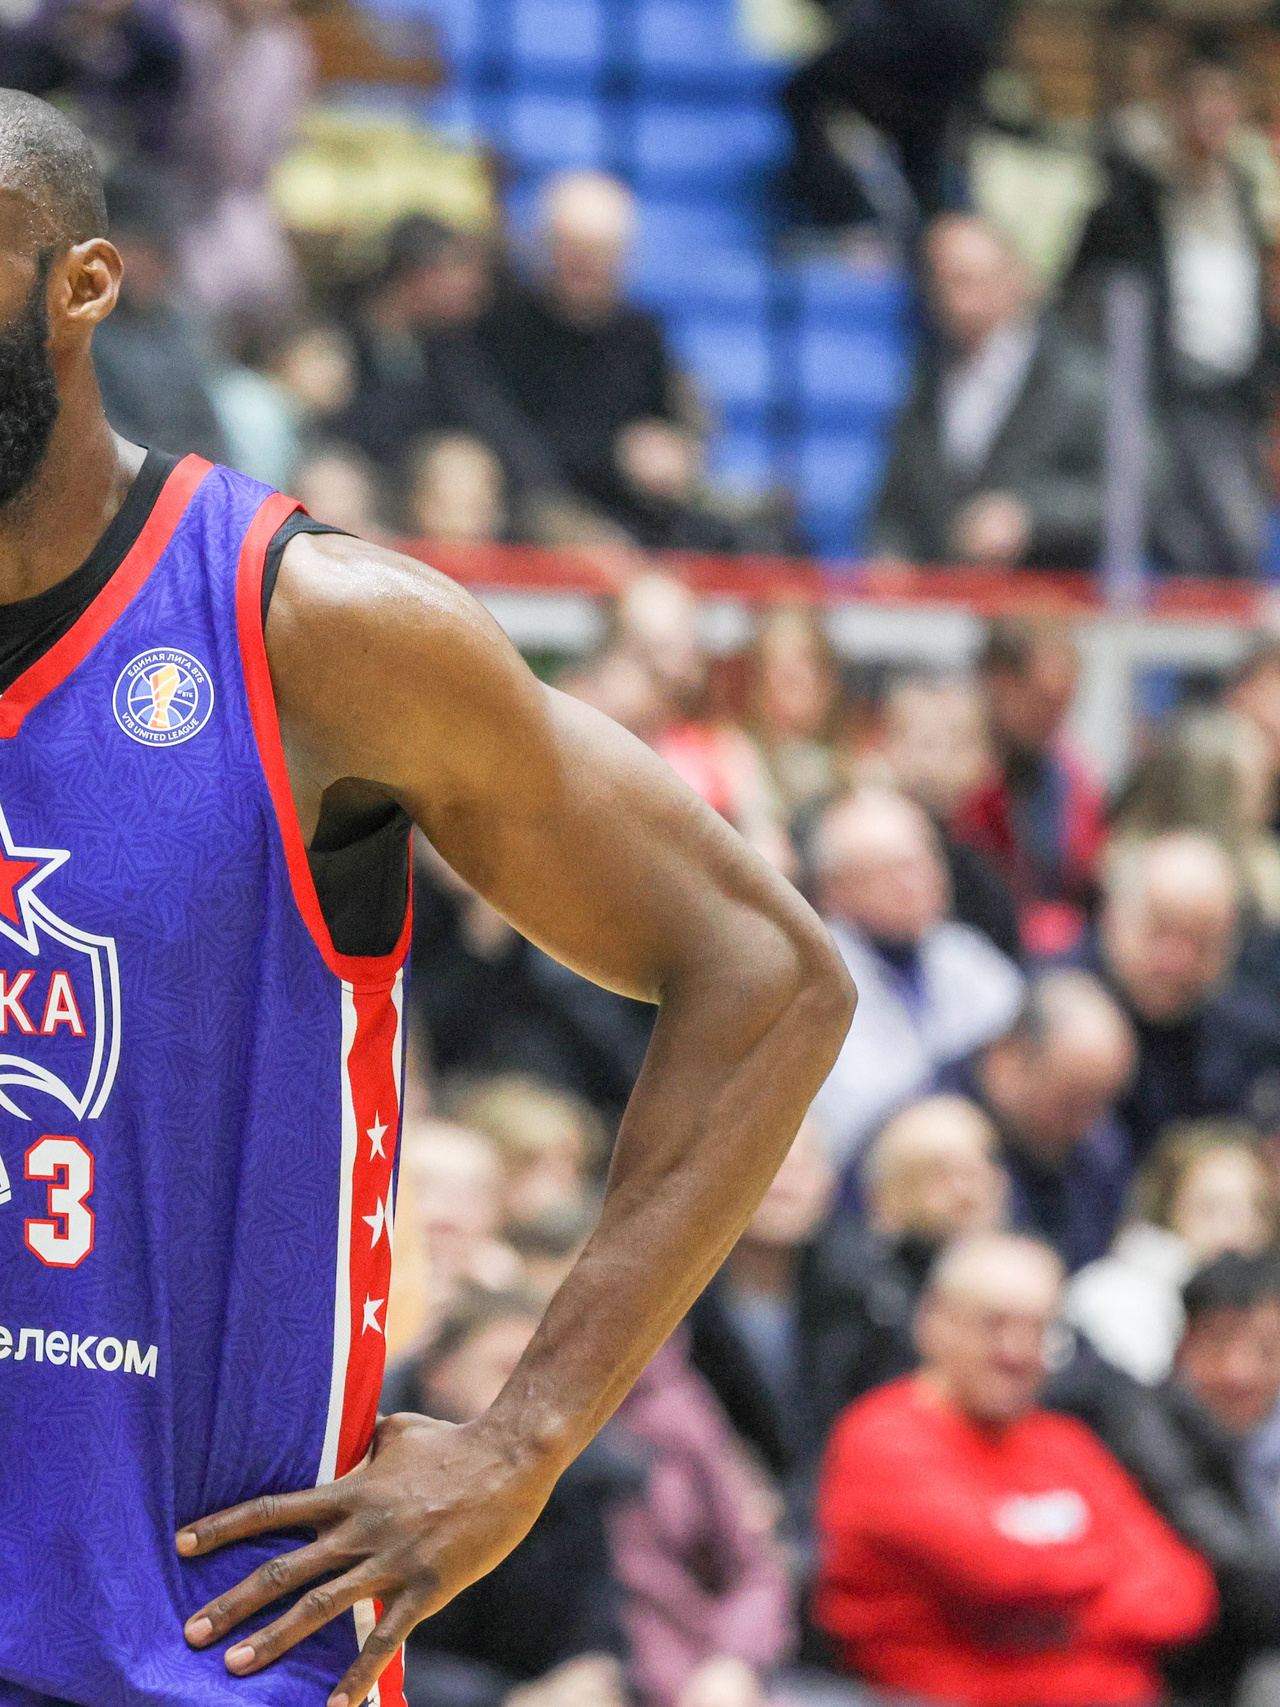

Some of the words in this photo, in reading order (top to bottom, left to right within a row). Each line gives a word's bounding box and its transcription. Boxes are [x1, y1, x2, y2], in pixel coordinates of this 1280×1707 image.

[127, 653, 165, 678] ЕДИНАЯ
[167, 653, 192, 670] ЛИГА
[190, 667, 205, 684] ВТБ
[121, 712, 135, 730] VTB
[133, 725, 166, 742] UNITED
[168, 718, 200, 741] LEAGUE
[24, 1134, 94, 1268] 3
